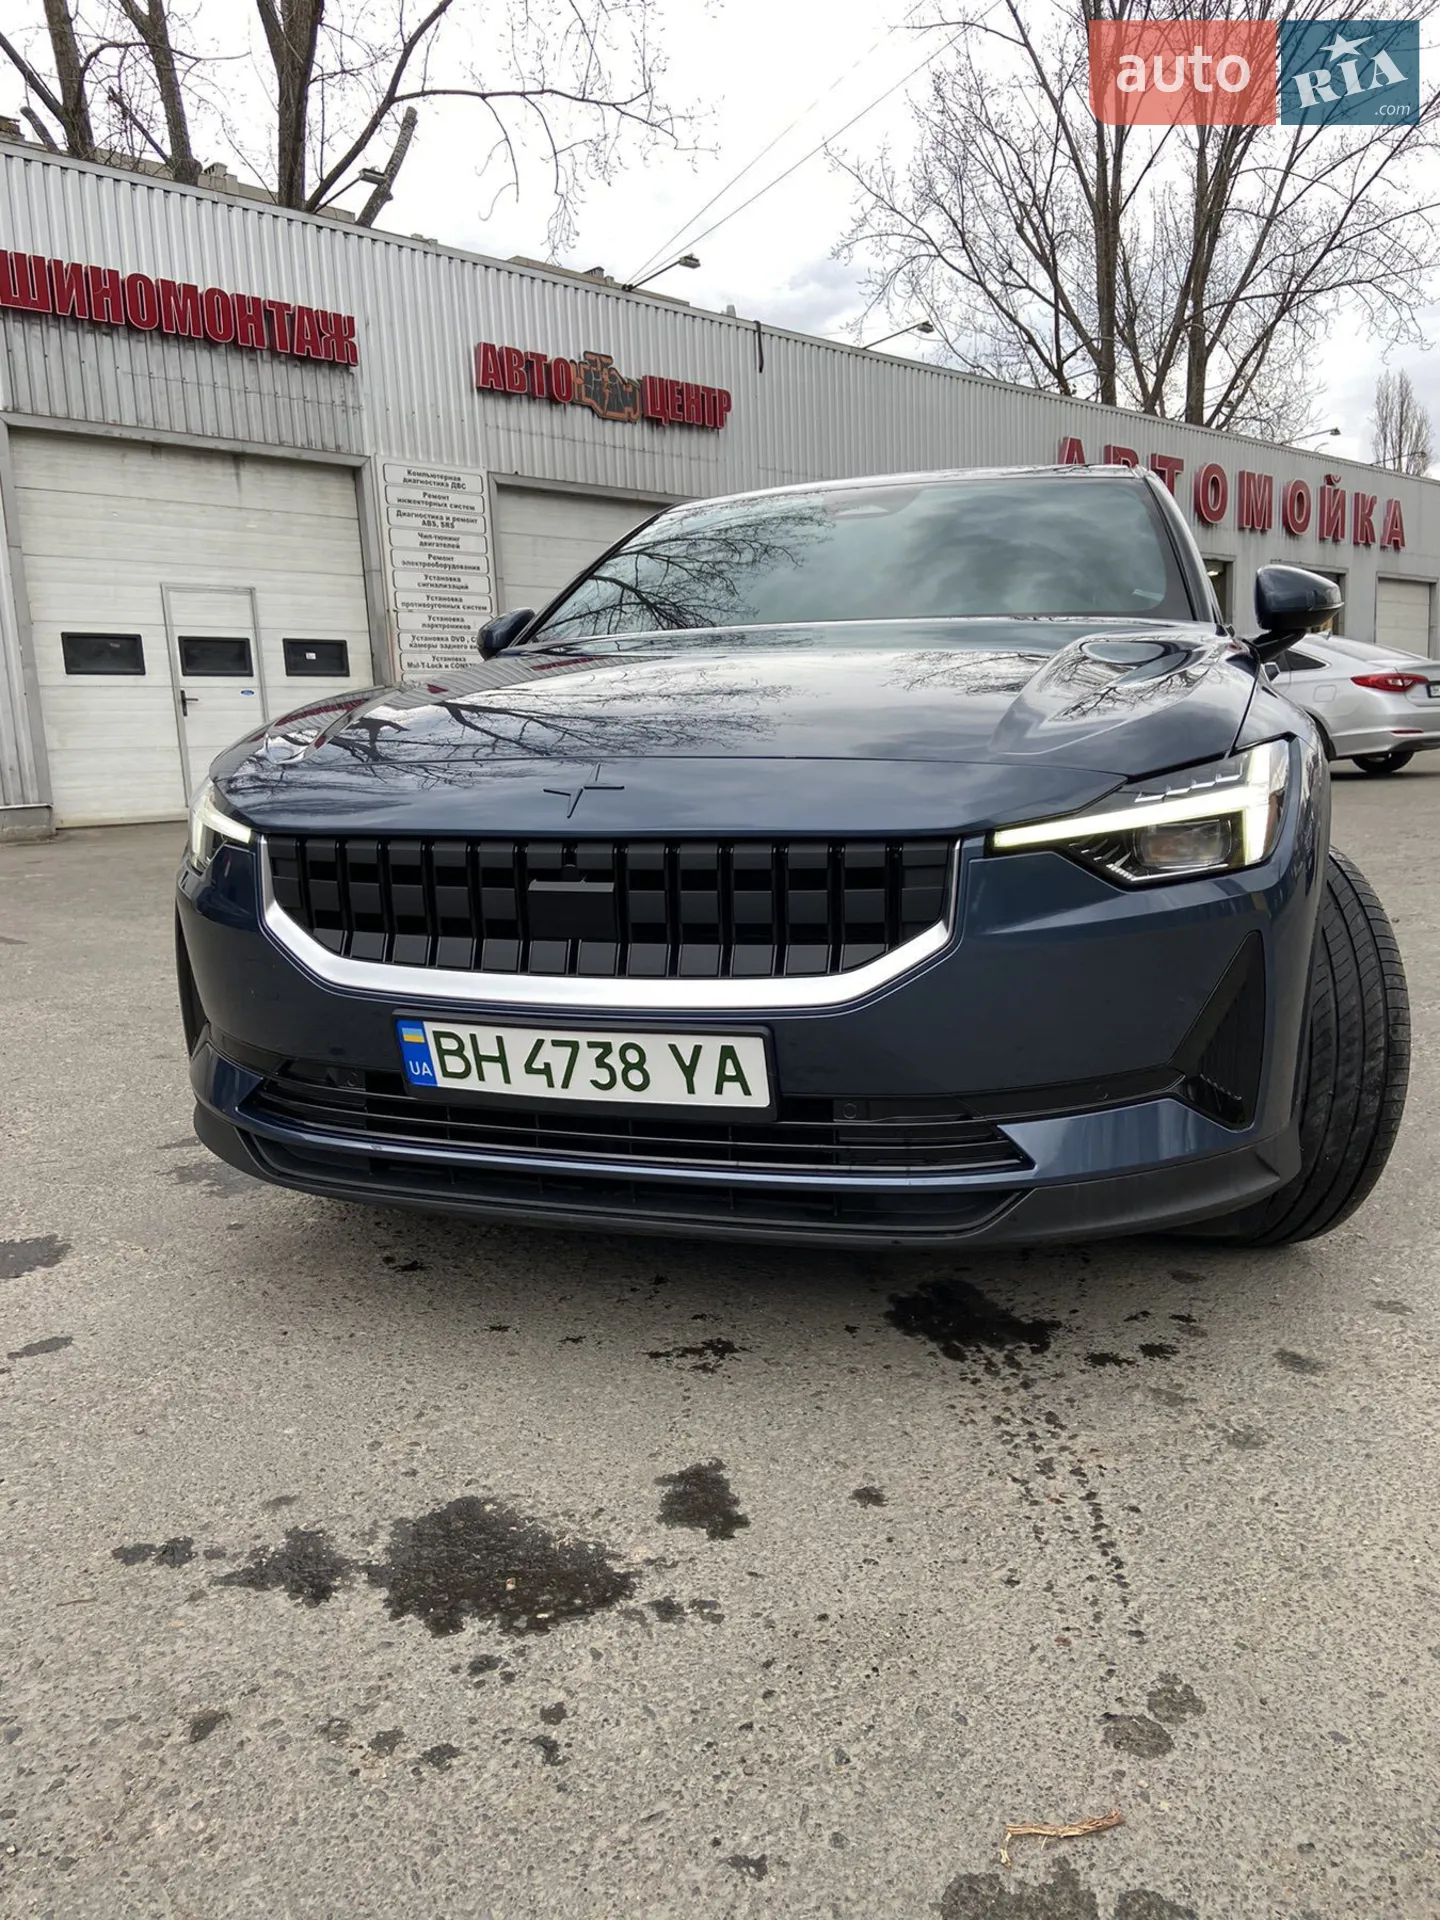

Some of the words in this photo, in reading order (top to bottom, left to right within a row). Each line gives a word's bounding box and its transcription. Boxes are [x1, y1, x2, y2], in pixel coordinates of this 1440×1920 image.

[0, 249, 359, 366] ШИНОМОНТАЖ
[475, 342, 574, 403] АВТО
[642, 375, 732, 429] ЦЕНТР
[407, 469, 461, 481] Компьютерная
[403, 478, 449, 488] диагностика
[451, 482, 466, 490] ДВС
[422, 492, 450, 500] Ремонт
[449, 503, 476, 511] систем
[396, 510, 444, 520] Диагностика
[452, 516, 477, 524] ремонт
[440, 521, 455, 529] SRS
[419, 541, 460, 549] двигателей
[402, 560, 480, 571] электрооборудования
[424, 574, 461, 582] Установка
[401, 602, 460, 610] противоугонных
[432, 1030, 511, 1085] BH
[523, 1038, 651, 1092] 4738
[667, 1043, 752, 1096] YA
[409, 1061, 433, 1077] UA
